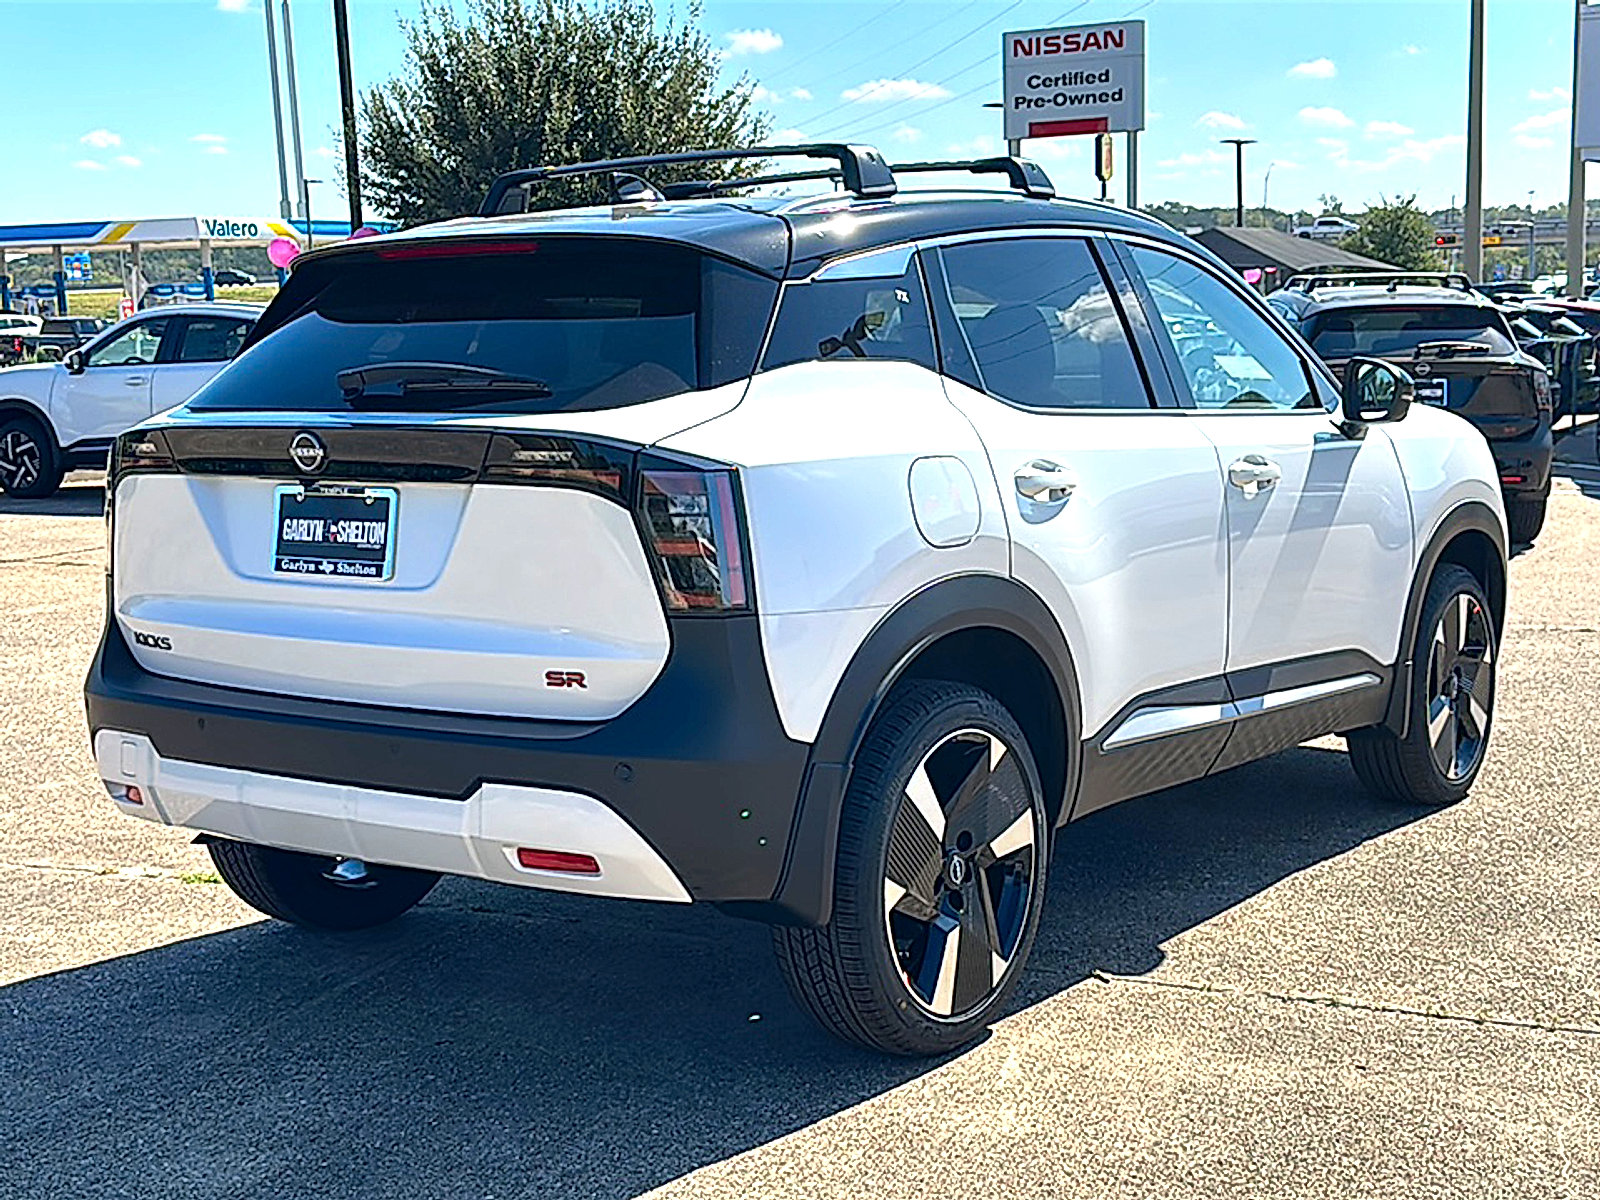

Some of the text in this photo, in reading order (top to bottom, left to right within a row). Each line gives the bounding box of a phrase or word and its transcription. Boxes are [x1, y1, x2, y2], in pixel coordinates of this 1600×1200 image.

[1013, 29, 1124, 58] NISSAN
[1026, 68, 1110, 90] Certified
[1014, 87, 1123, 110] Pre-Owned
[205, 219, 258, 237] Valero
[282, 518, 386, 545] GARLYN SHELTON
[281, 559, 377, 576] Garlyn Shelton
[133, 631, 172, 651] KICKS
[544, 670, 588, 689] SR
